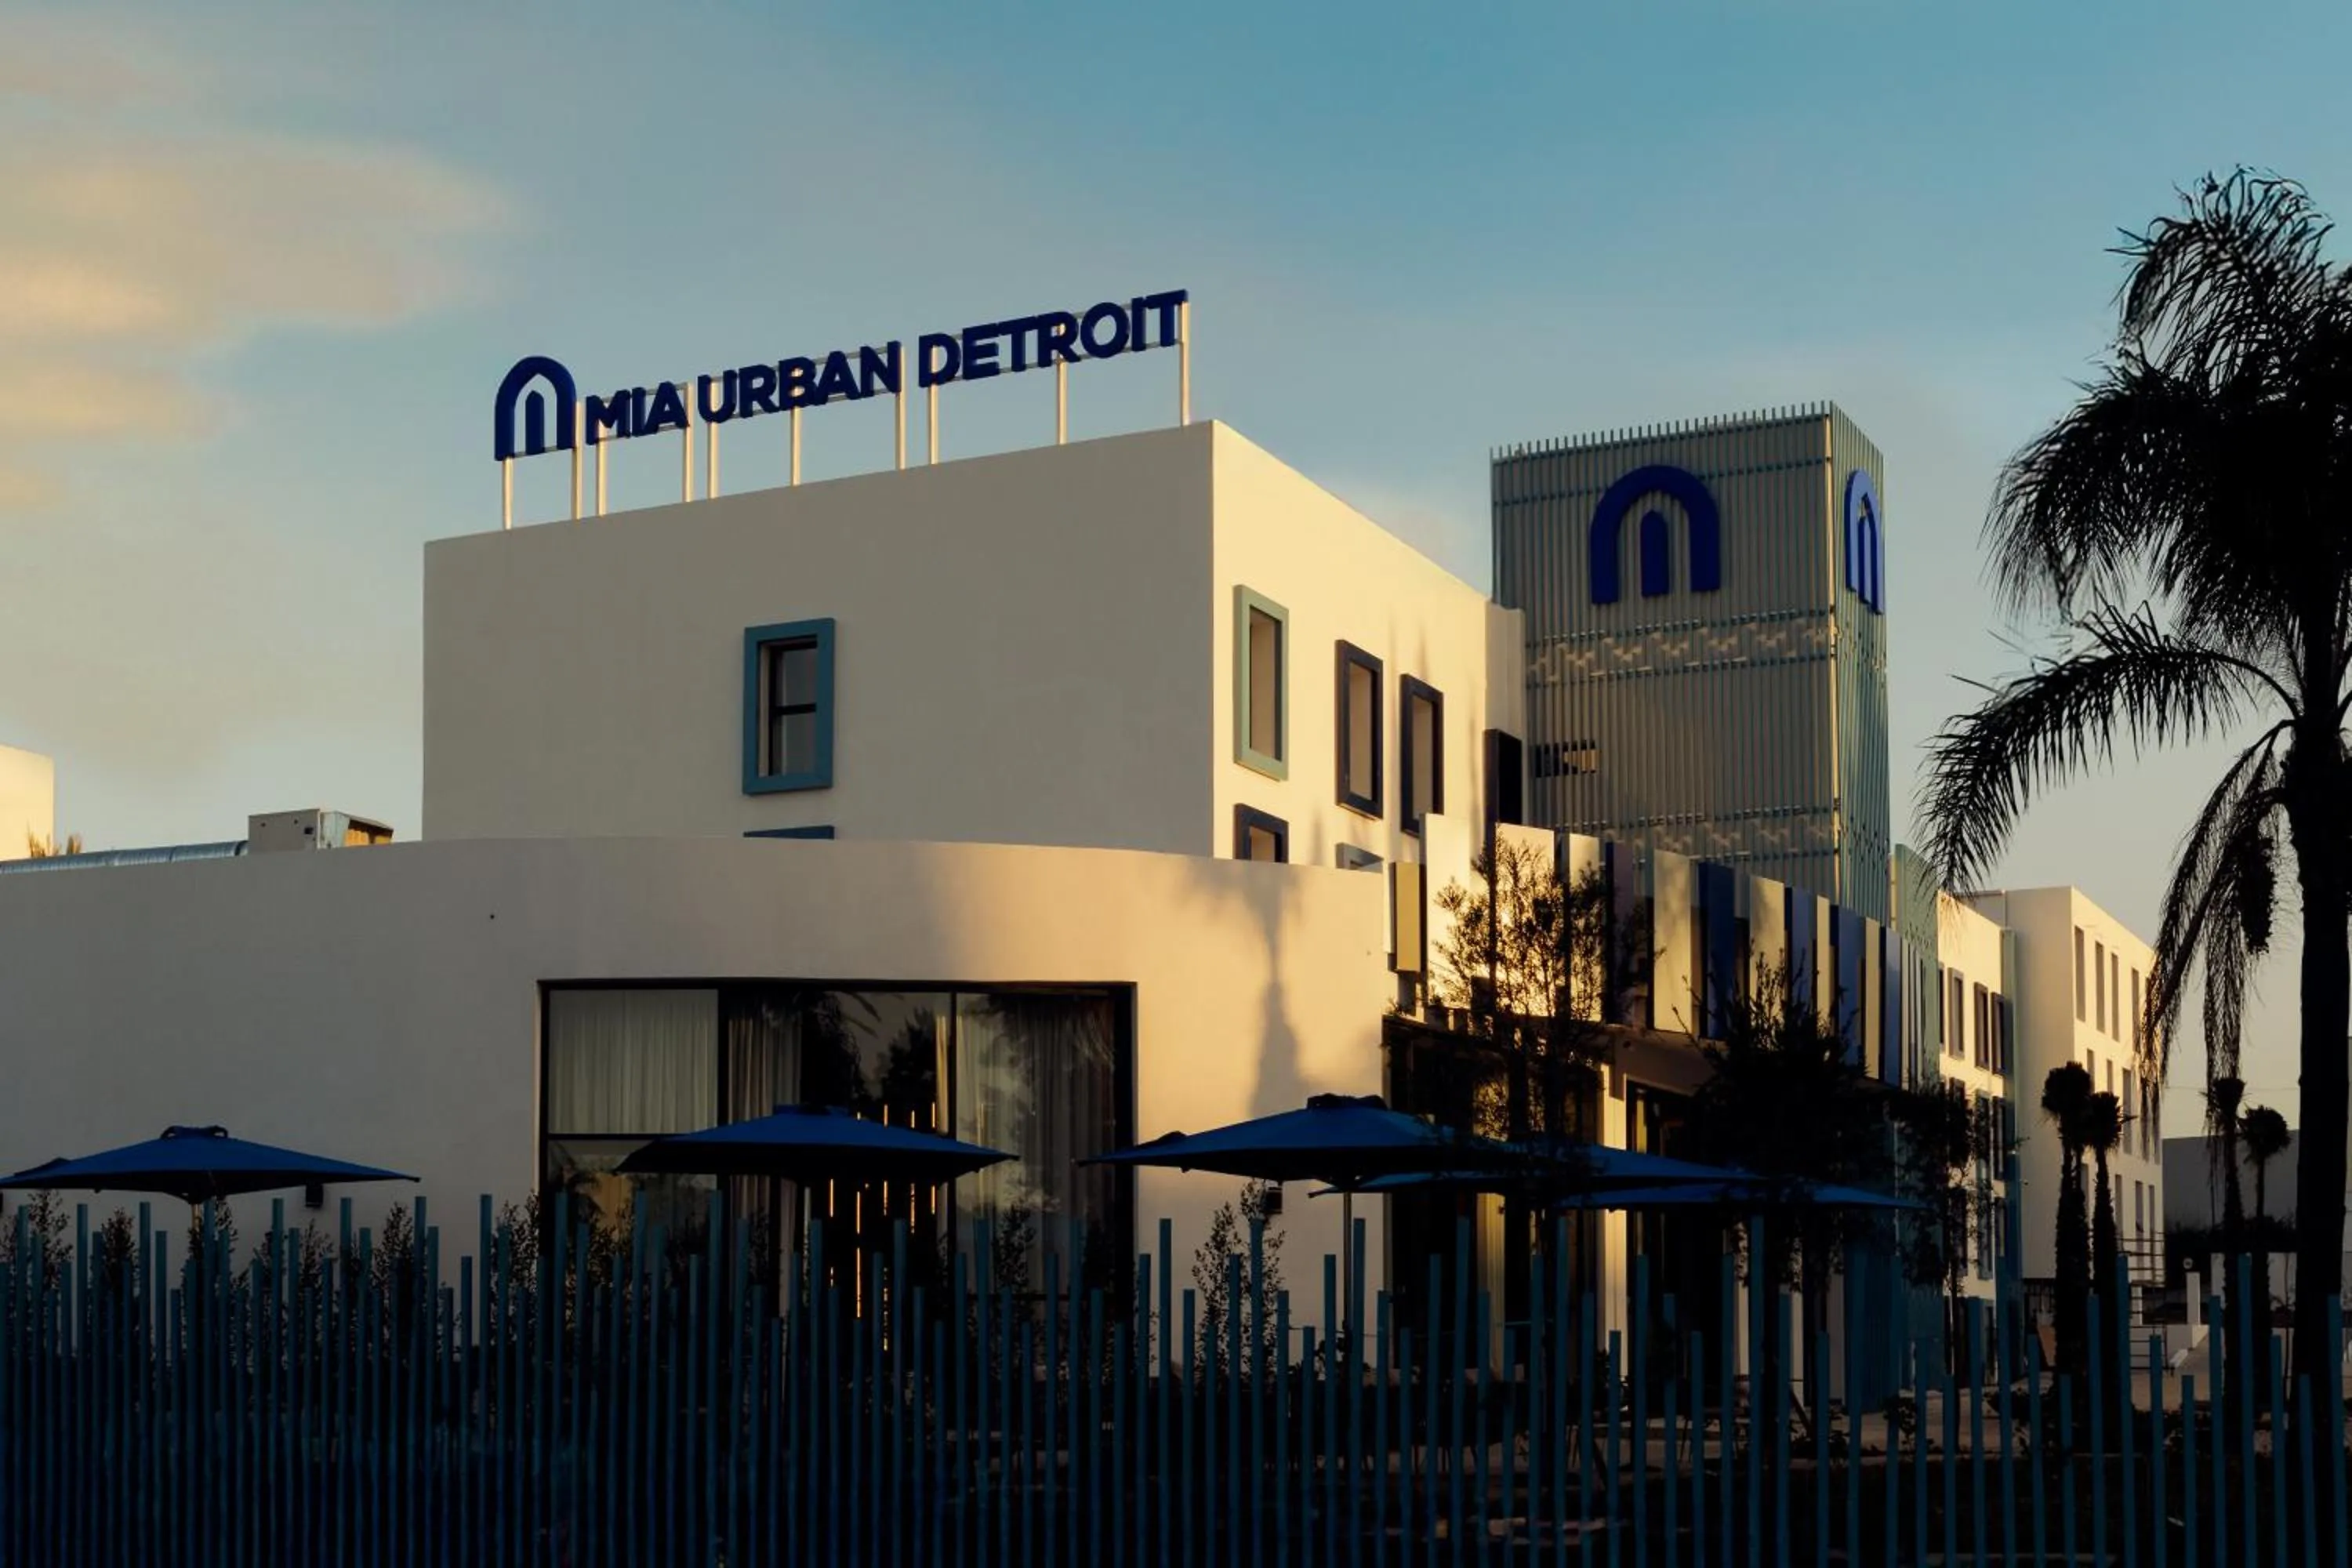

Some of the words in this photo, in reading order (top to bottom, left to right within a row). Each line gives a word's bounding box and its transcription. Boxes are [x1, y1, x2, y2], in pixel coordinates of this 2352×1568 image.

[586, 382, 689, 445] MIA
[697, 340, 901, 423] URBAN
[918, 289, 1188, 387] DETROIT
